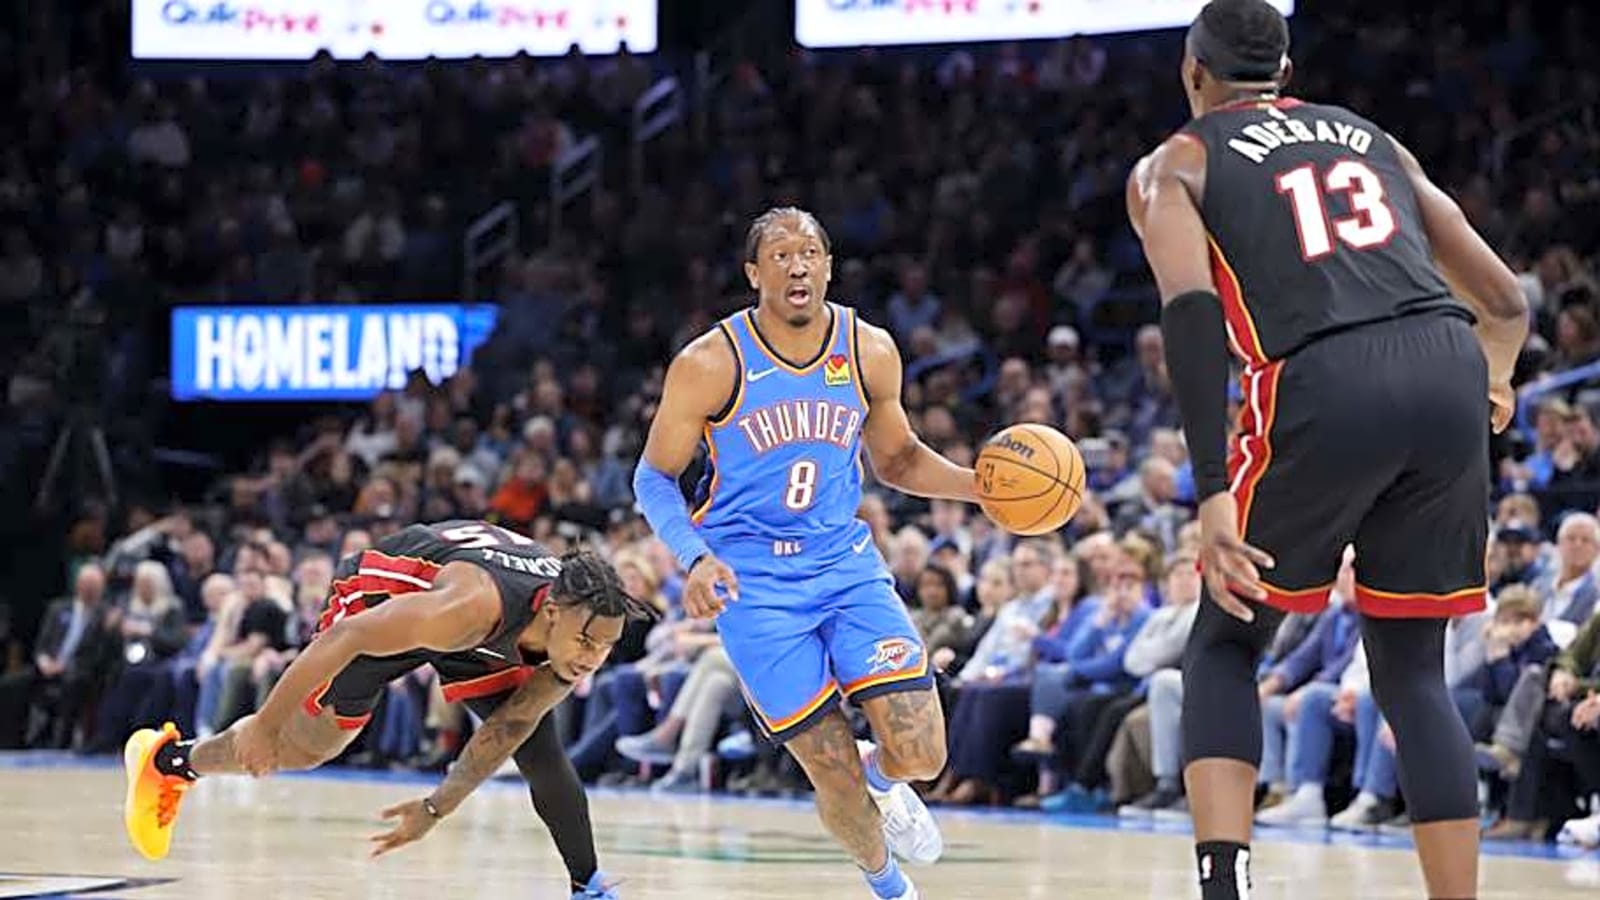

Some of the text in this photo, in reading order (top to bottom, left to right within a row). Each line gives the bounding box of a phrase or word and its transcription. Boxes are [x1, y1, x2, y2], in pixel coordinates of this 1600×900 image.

[1228, 119, 1373, 164] ADEBAYO
[1276, 157, 1397, 261] 13
[196, 313, 459, 389] HOMELAND
[738, 400, 861, 452] THUNDER
[785, 459, 817, 510] 8
